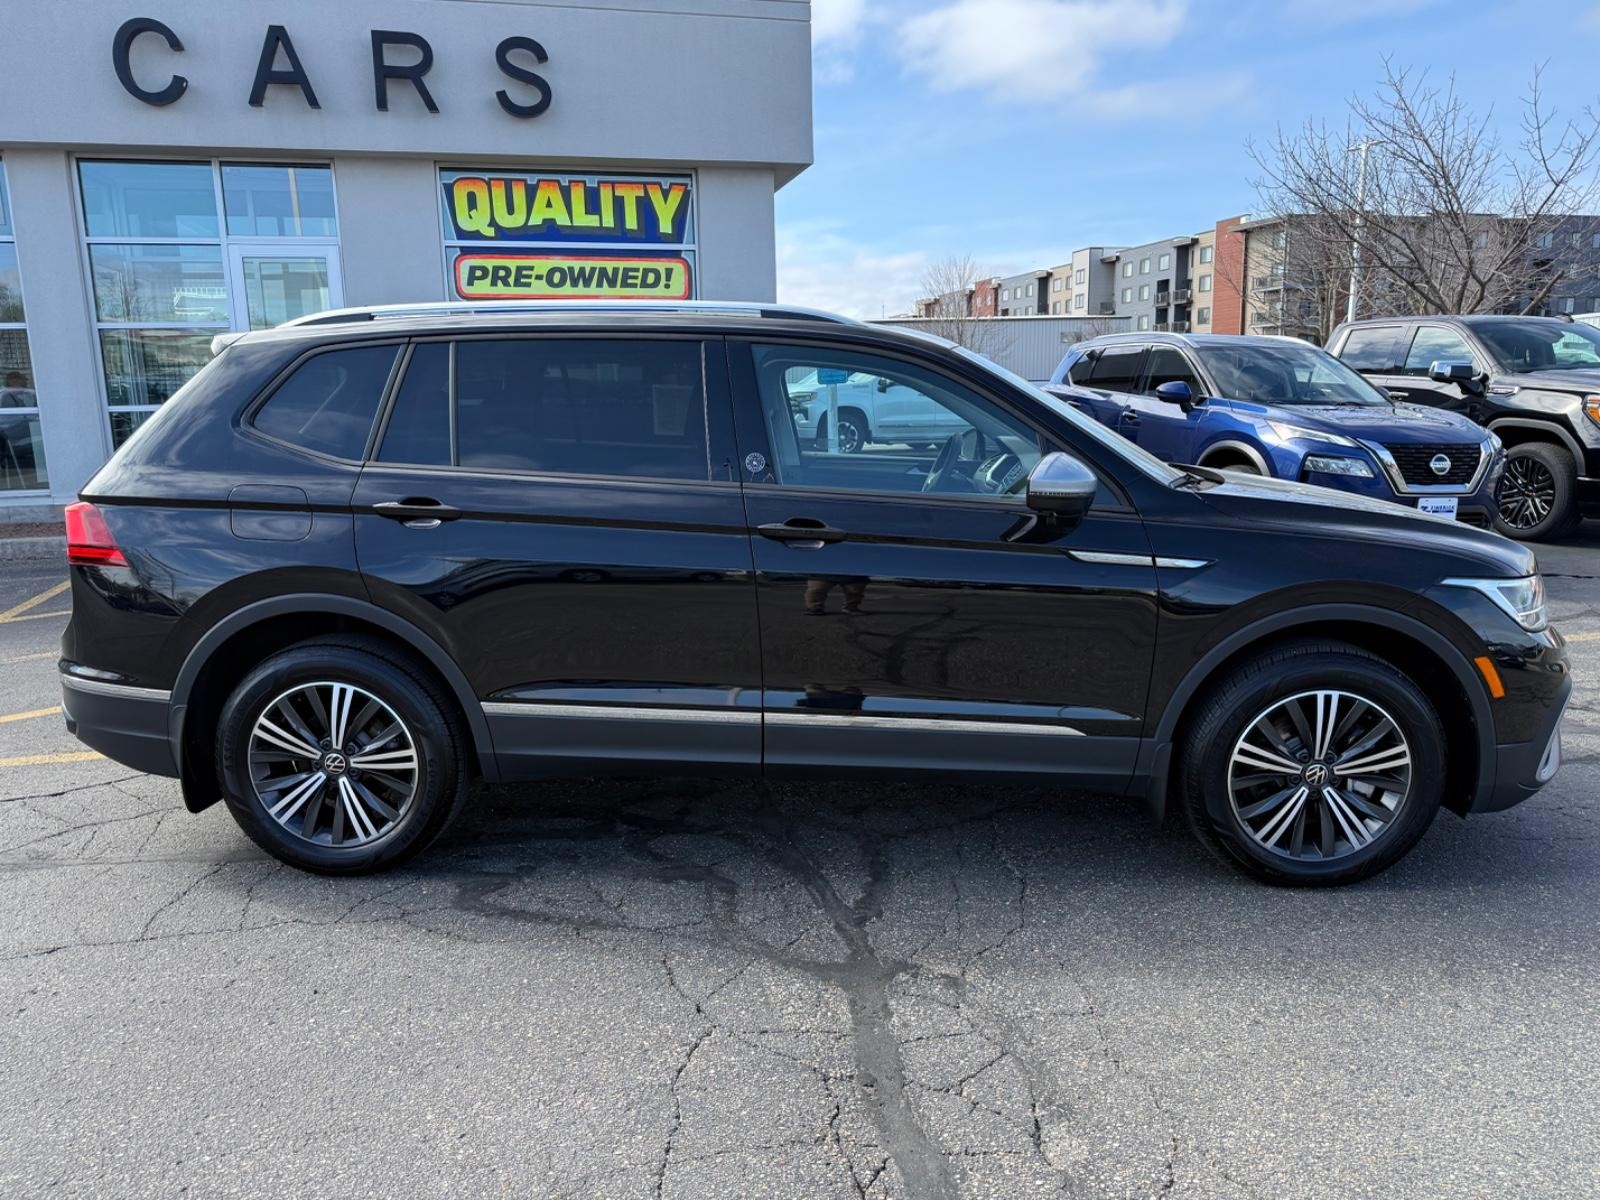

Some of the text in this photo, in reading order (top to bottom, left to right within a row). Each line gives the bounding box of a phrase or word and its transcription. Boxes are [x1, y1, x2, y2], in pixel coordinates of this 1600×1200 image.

[112, 17, 553, 119] CARS
[452, 177, 688, 238] QUALITY
[466, 265, 674, 290] PRE-OWNED!
